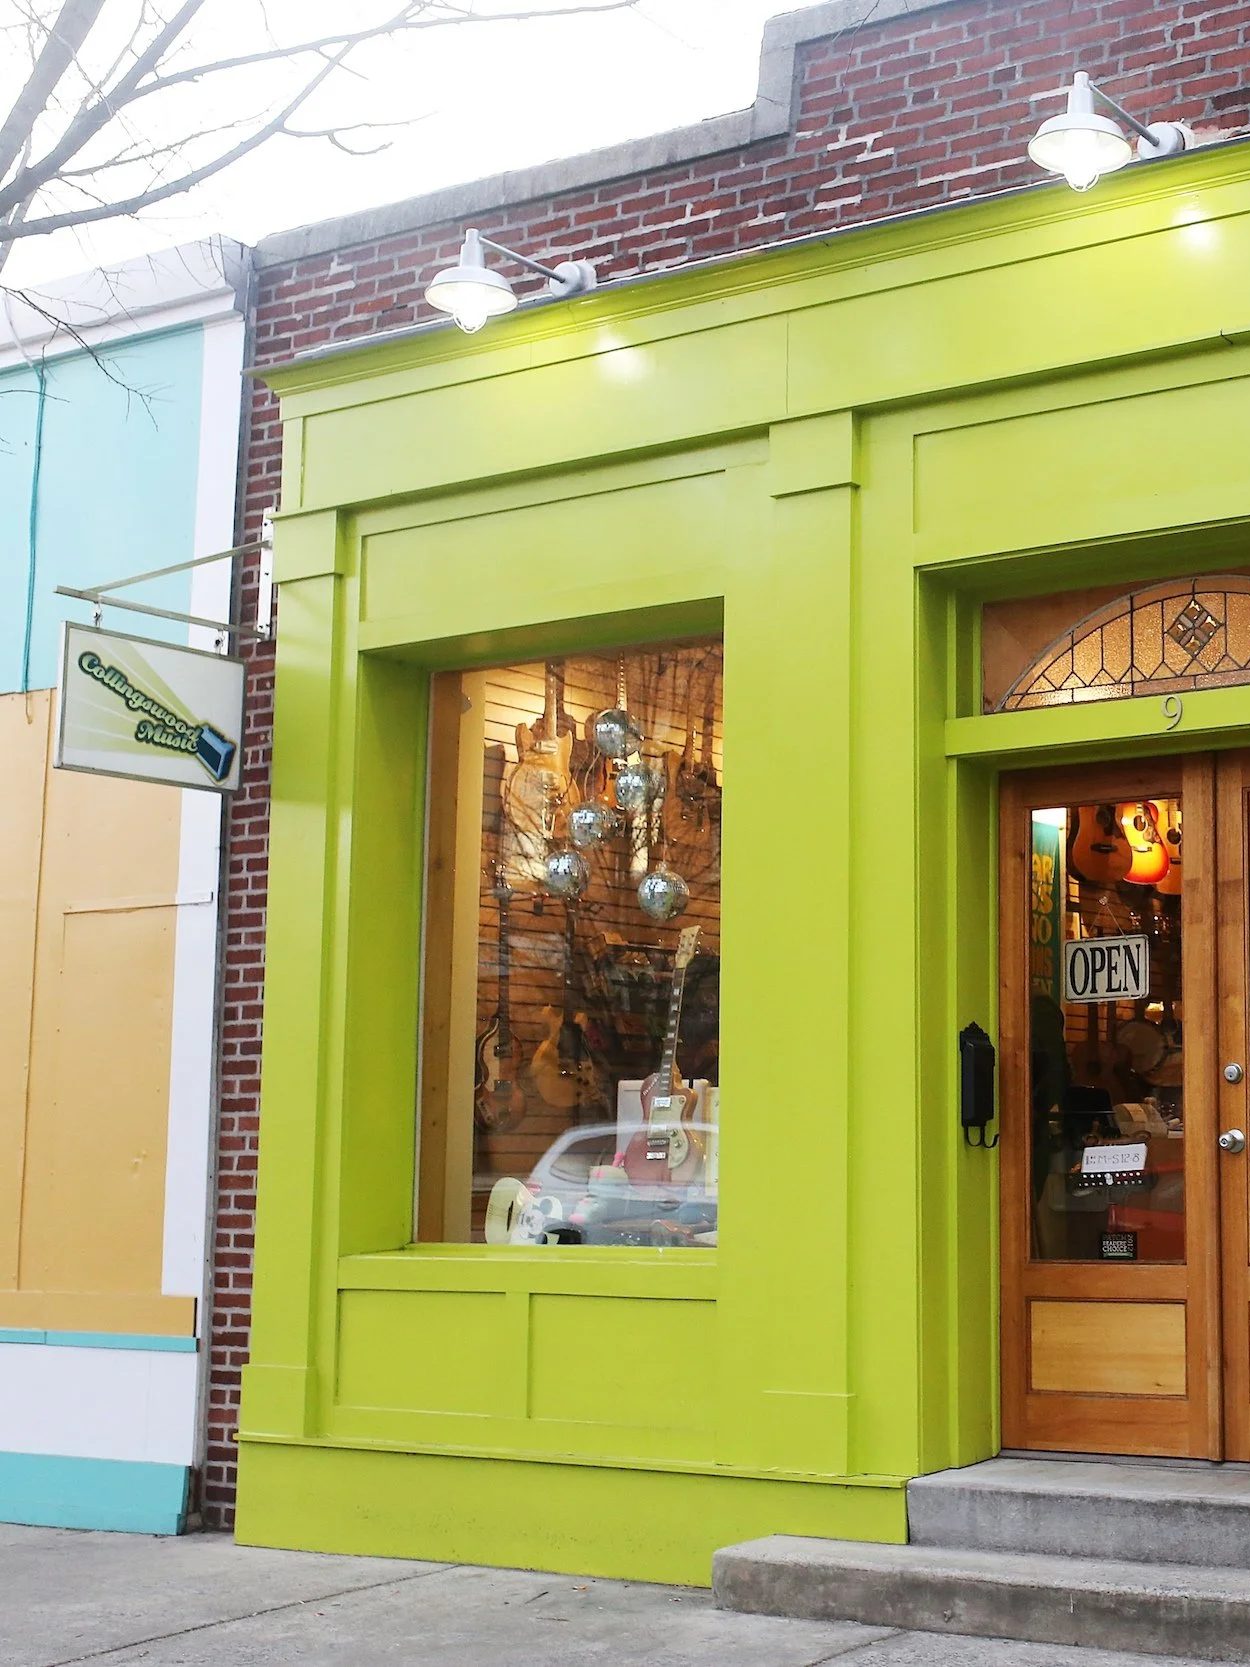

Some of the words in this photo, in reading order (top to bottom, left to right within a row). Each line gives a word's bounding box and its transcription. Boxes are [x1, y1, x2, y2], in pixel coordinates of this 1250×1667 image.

[79, 652, 203, 742] Collingswood
[1162, 695, 1182, 731] 9
[136, 720, 199, 753] Music
[1069, 944, 1141, 996] OPEN
